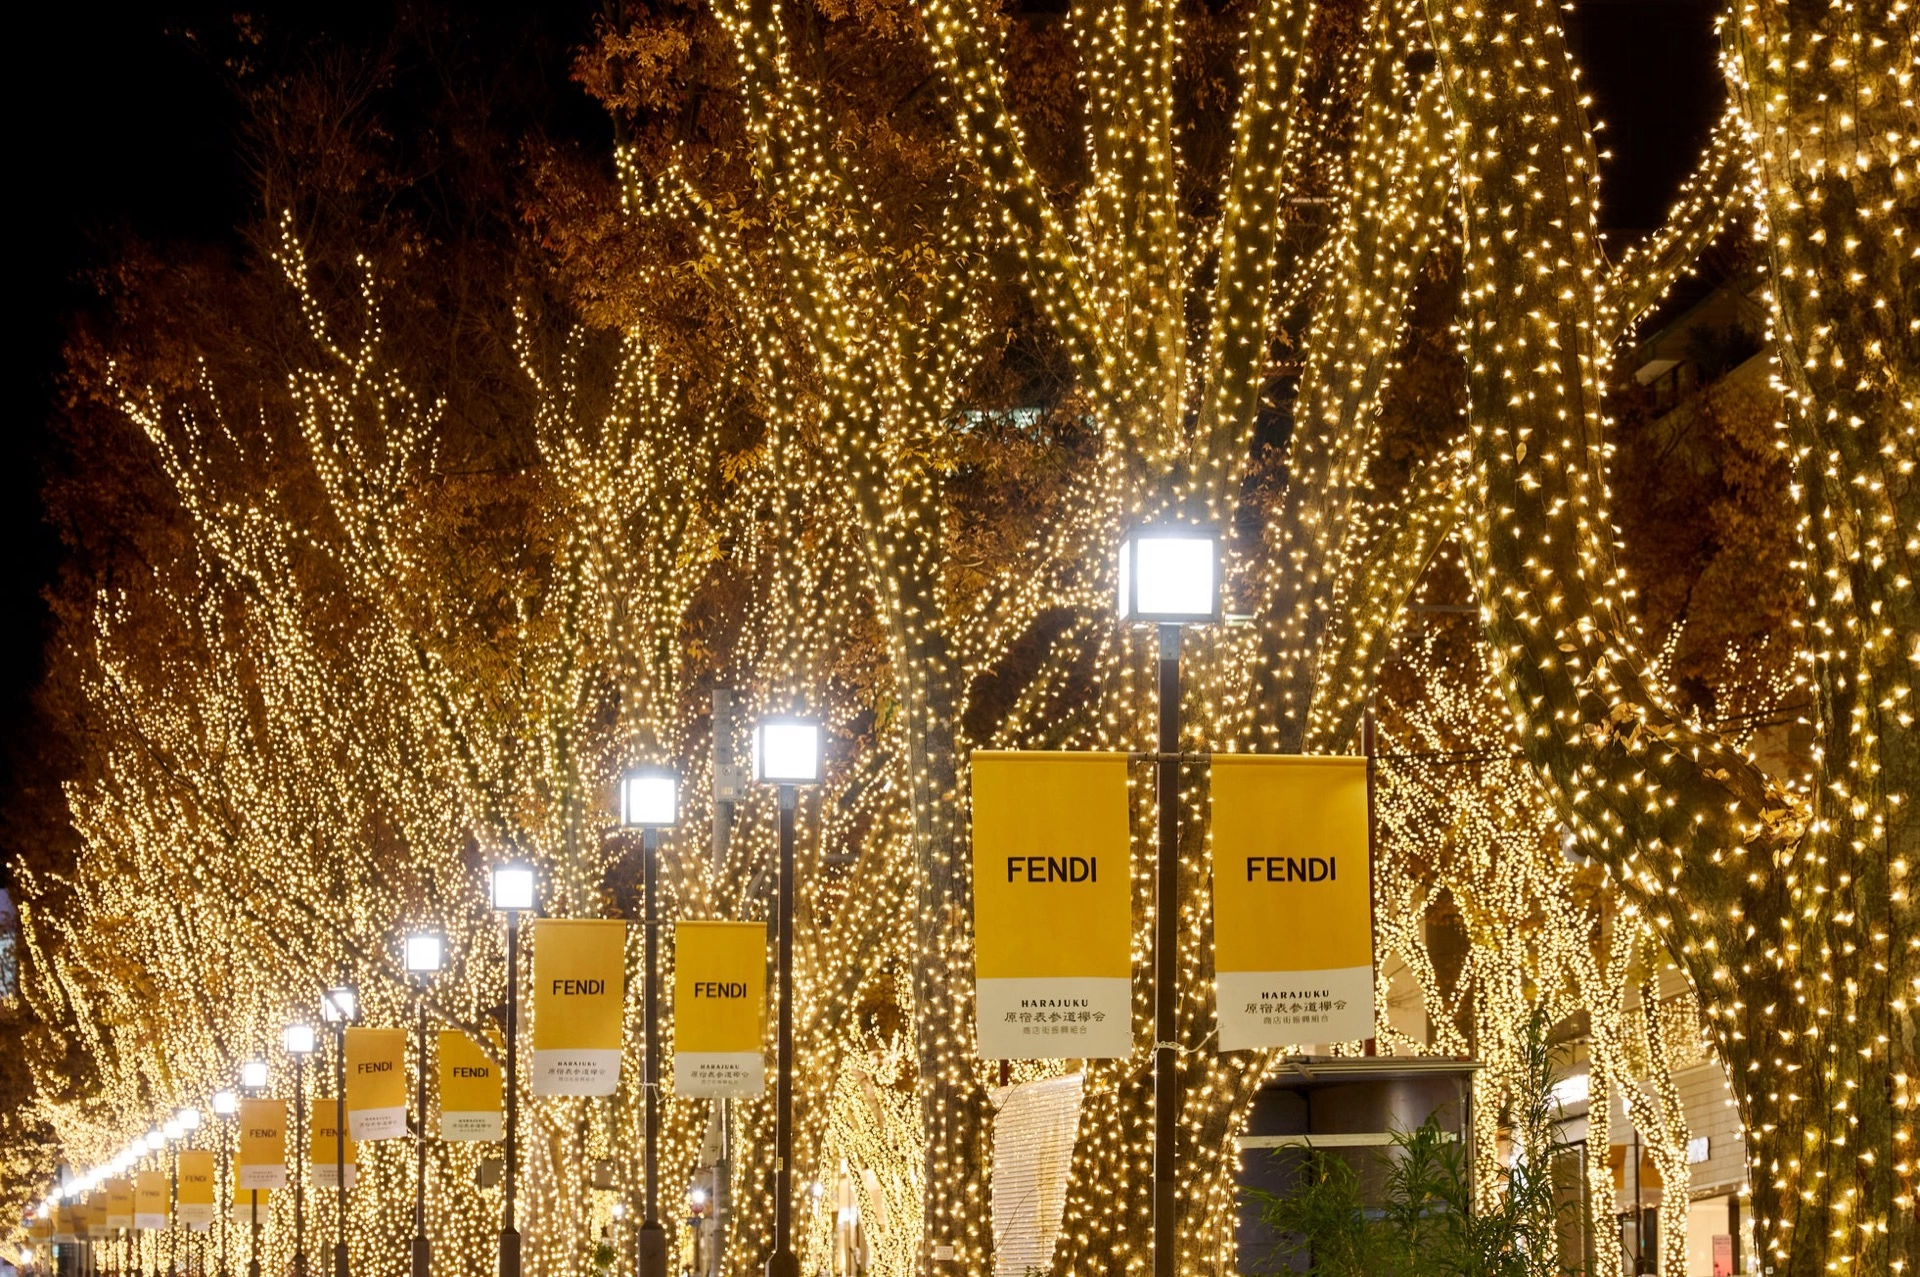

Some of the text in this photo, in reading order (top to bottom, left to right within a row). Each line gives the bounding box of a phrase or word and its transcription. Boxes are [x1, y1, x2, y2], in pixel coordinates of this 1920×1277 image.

[1008, 857, 1097, 882] FENDI
[1247, 857, 1336, 882] FENDI
[552, 980, 605, 995] FENDI
[694, 982, 747, 998] FENDI
[1261, 990, 1329, 1000] HARAJUKU
[1021, 999, 1089, 1008] HARAJUKU
[358, 1061, 393, 1074] FENDI
[454, 1067, 489, 1078] FENDI
[249, 1128, 277, 1138] FENDI
[320, 1128, 347, 1137] FENI
[185, 1175, 207, 1183] FENDI
